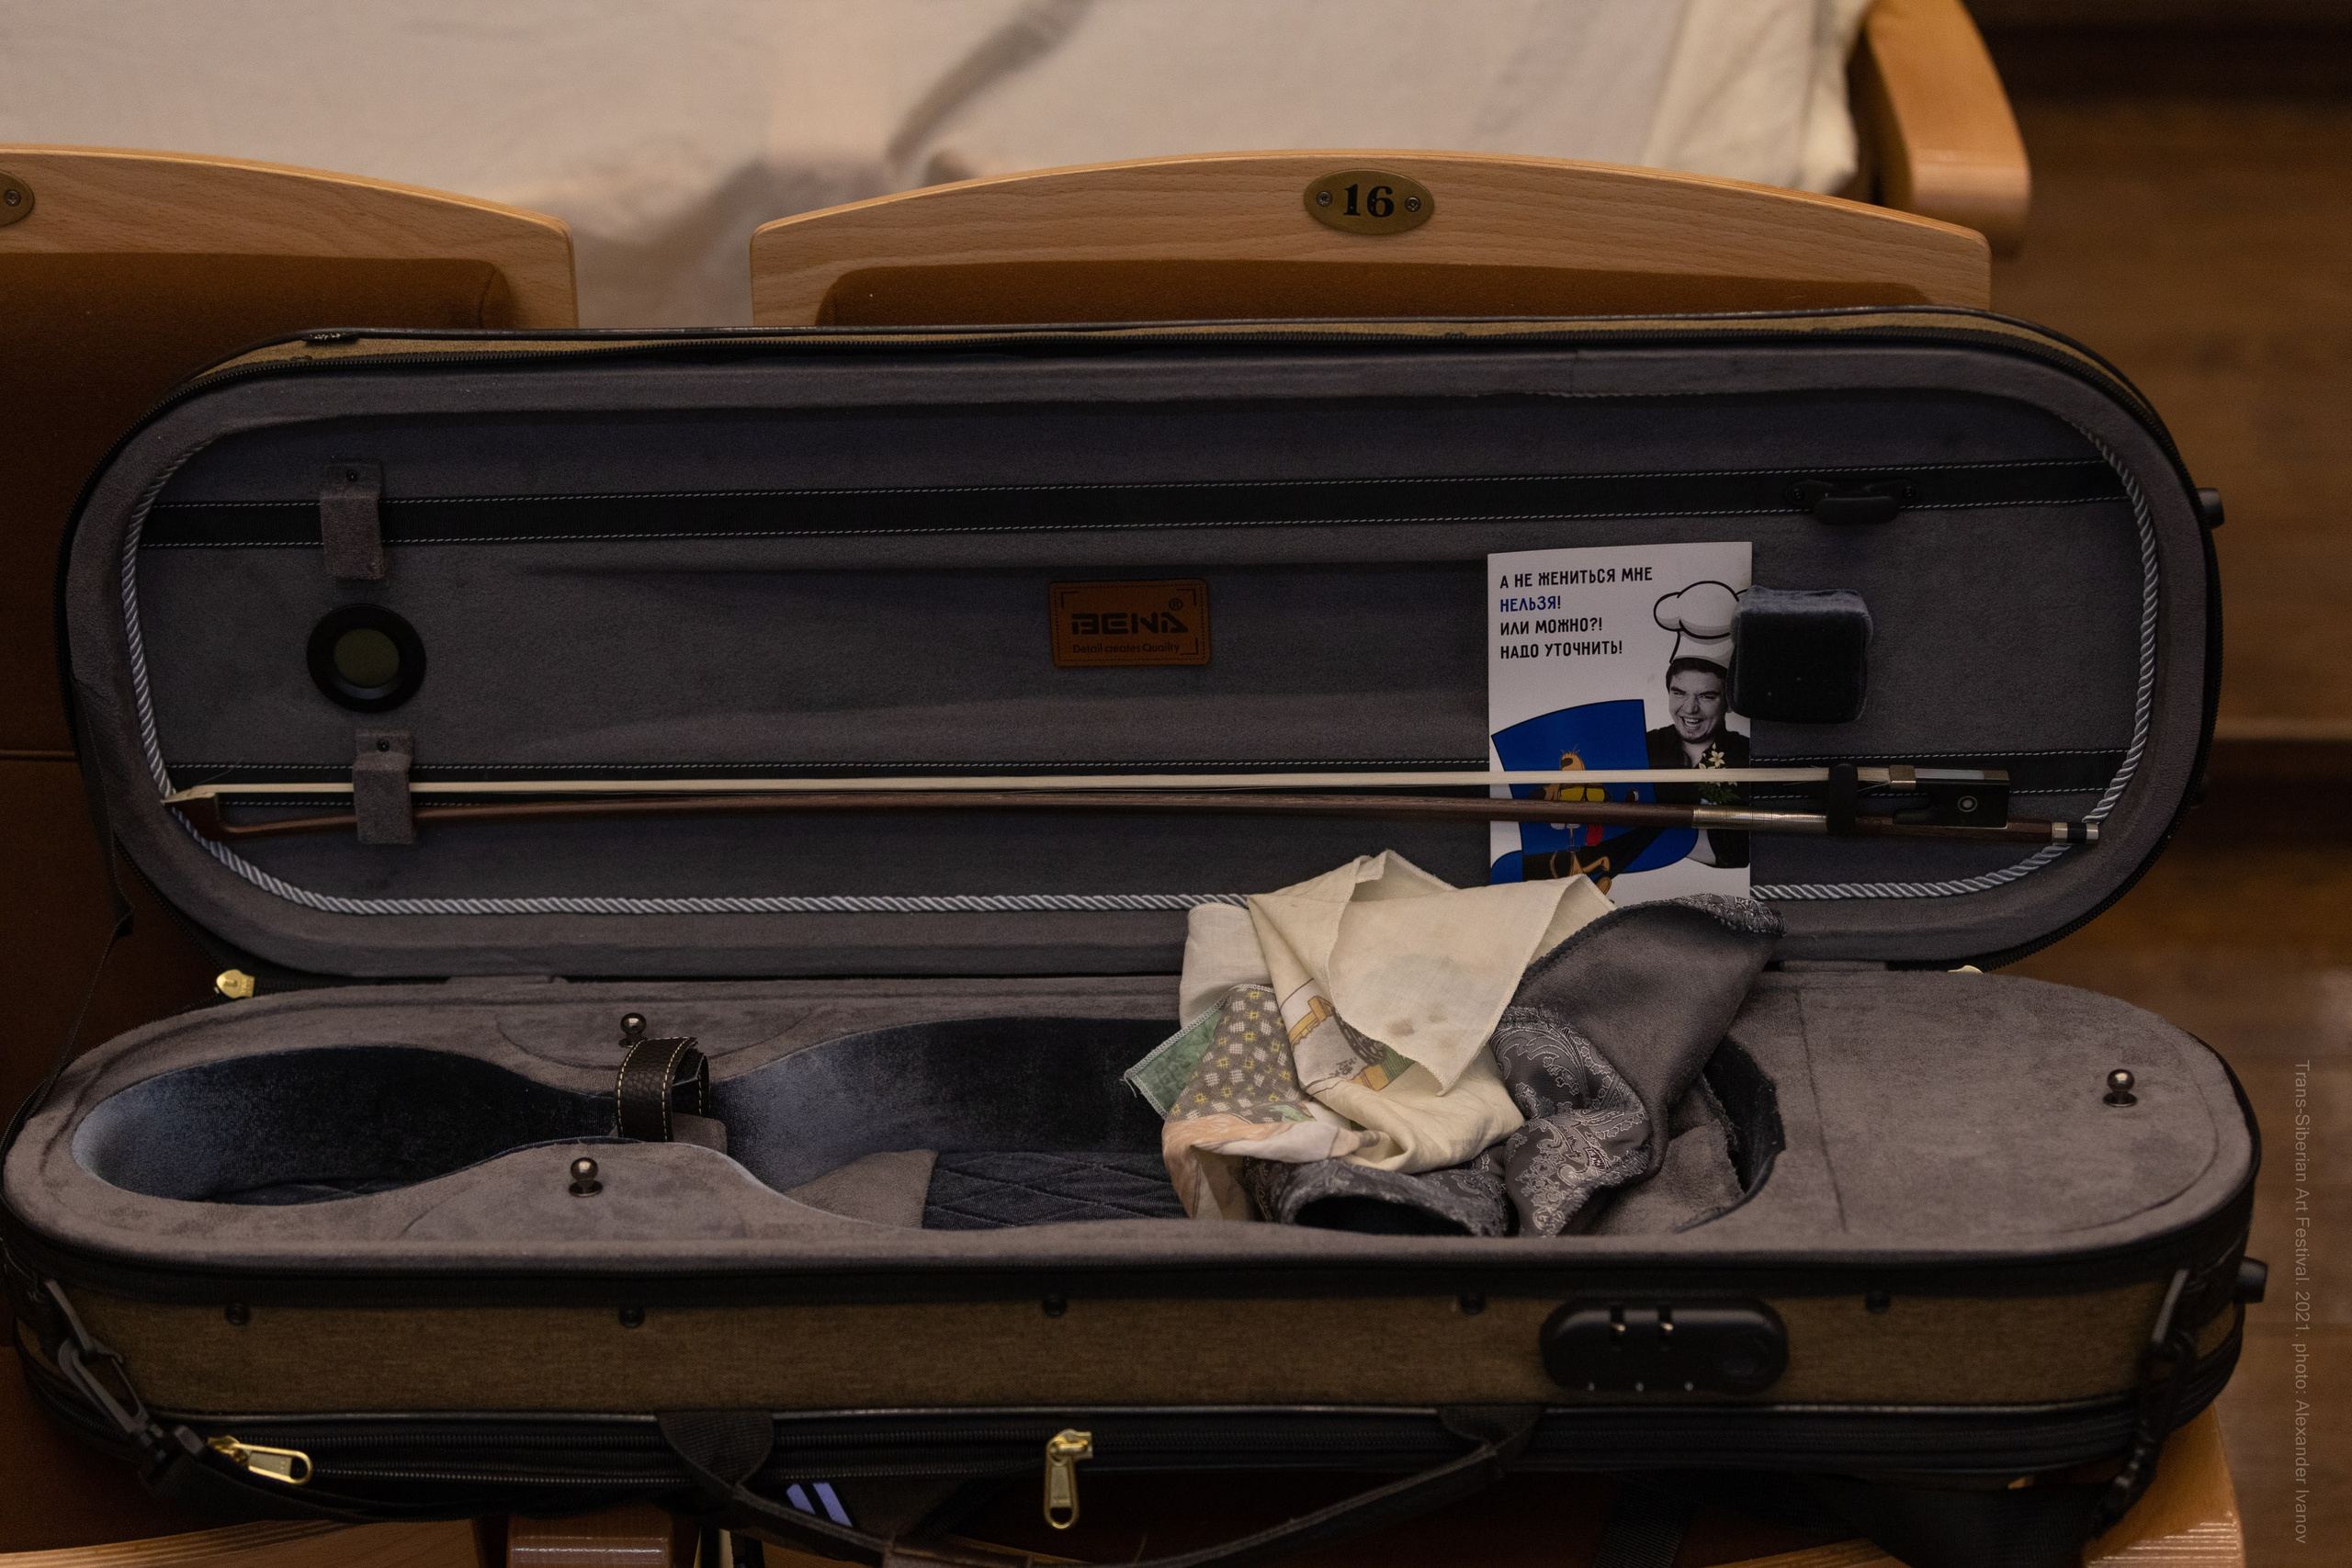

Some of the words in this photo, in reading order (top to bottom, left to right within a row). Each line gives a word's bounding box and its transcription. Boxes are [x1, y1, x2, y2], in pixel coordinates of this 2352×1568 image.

[1342, 183, 1395, 218] 16
[1499, 574, 1509, 589] А
[1514, 572, 1533, 588] НЕ
[1538, 568, 1616, 586] ЖЕНИТЬСЯ
[1621, 566, 1653, 582] МНЕ
[1499, 595, 1562, 613] НЕЛЬЗЯ!
[1071, 611, 1189, 635] BENA
[1499, 621, 1530, 636] ИЛИ
[1535, 616, 1602, 634] МОЖНО?!
[1072, 642, 1102, 654] Detail
[1104, 643, 1141, 654] creates
[1499, 644, 1540, 660] НАДО
[1544, 639, 1623, 658] УТОЧНИТЬ!
